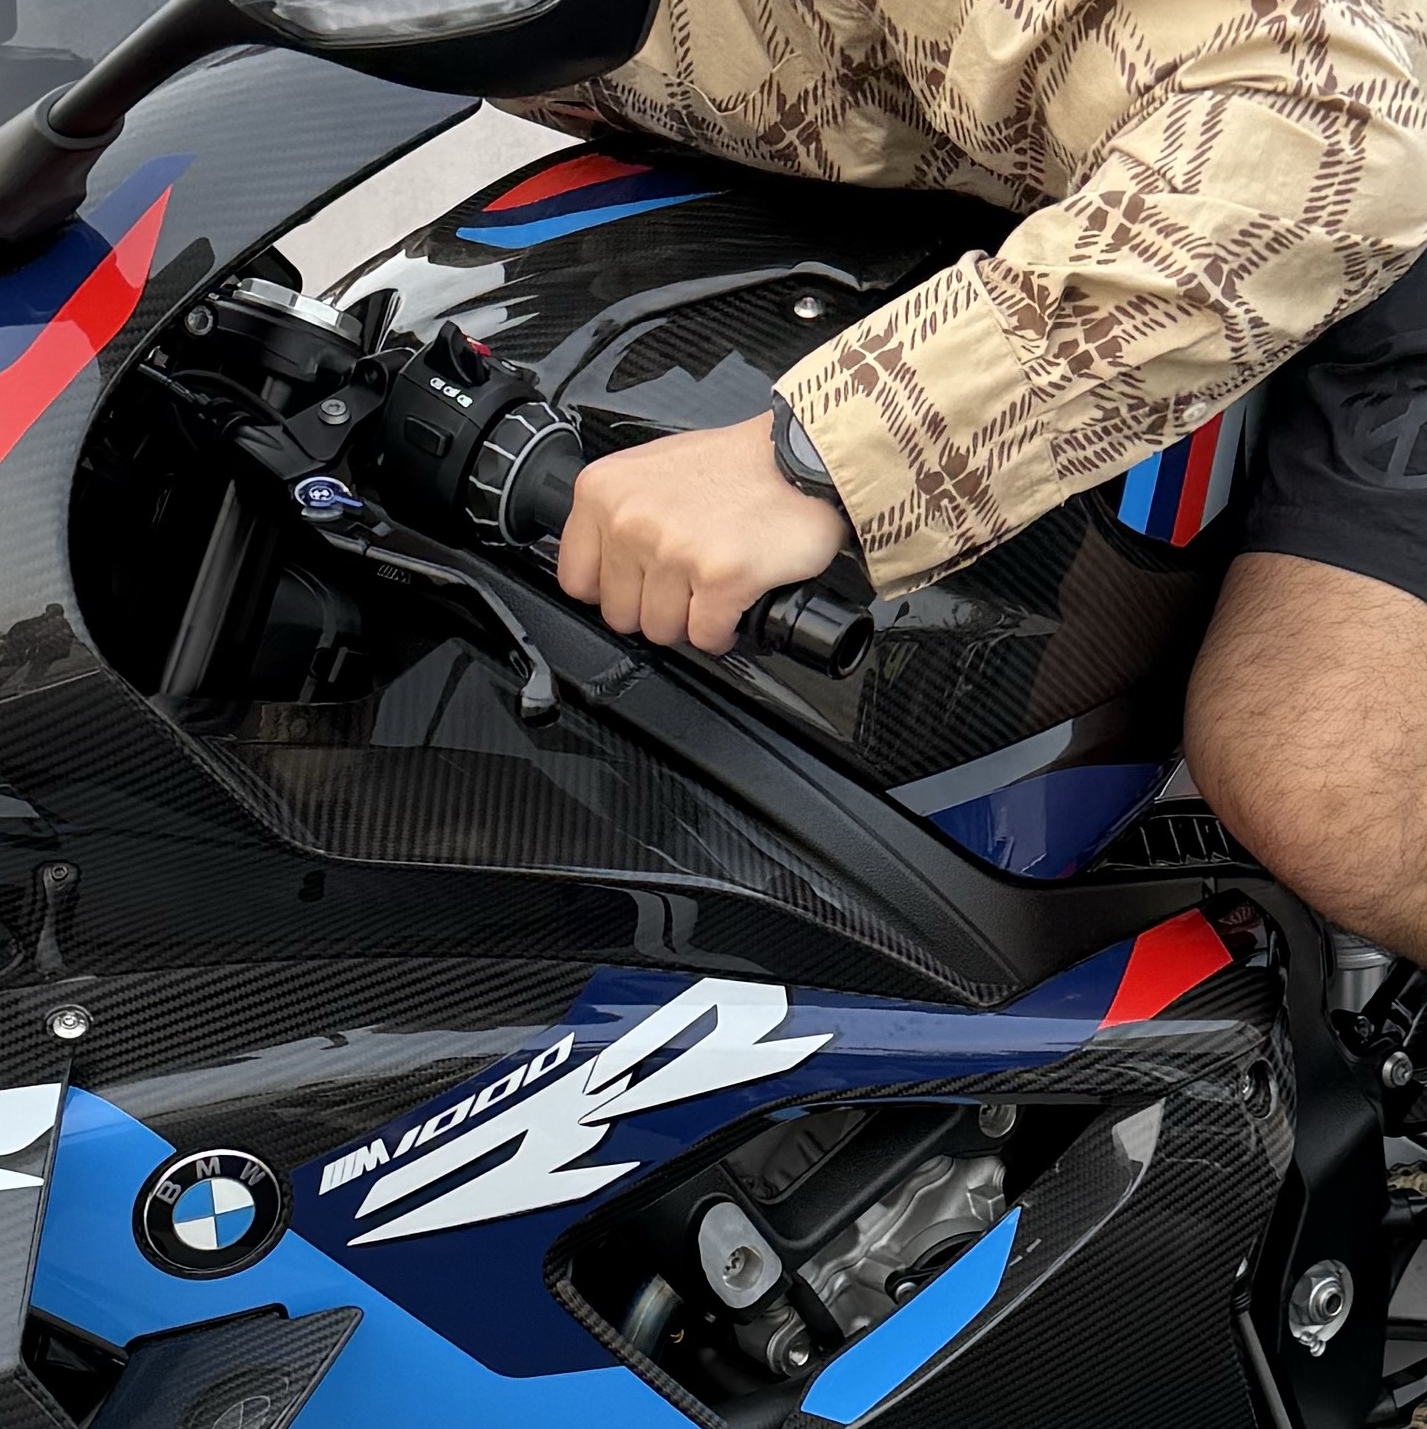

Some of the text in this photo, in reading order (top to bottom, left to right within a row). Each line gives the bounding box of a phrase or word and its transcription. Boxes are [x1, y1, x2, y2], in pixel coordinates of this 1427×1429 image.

[347, 977, 835, 1247] RR
[392, 1031, 576, 1159] 1000
[156, 1156, 268, 1206] BMW
